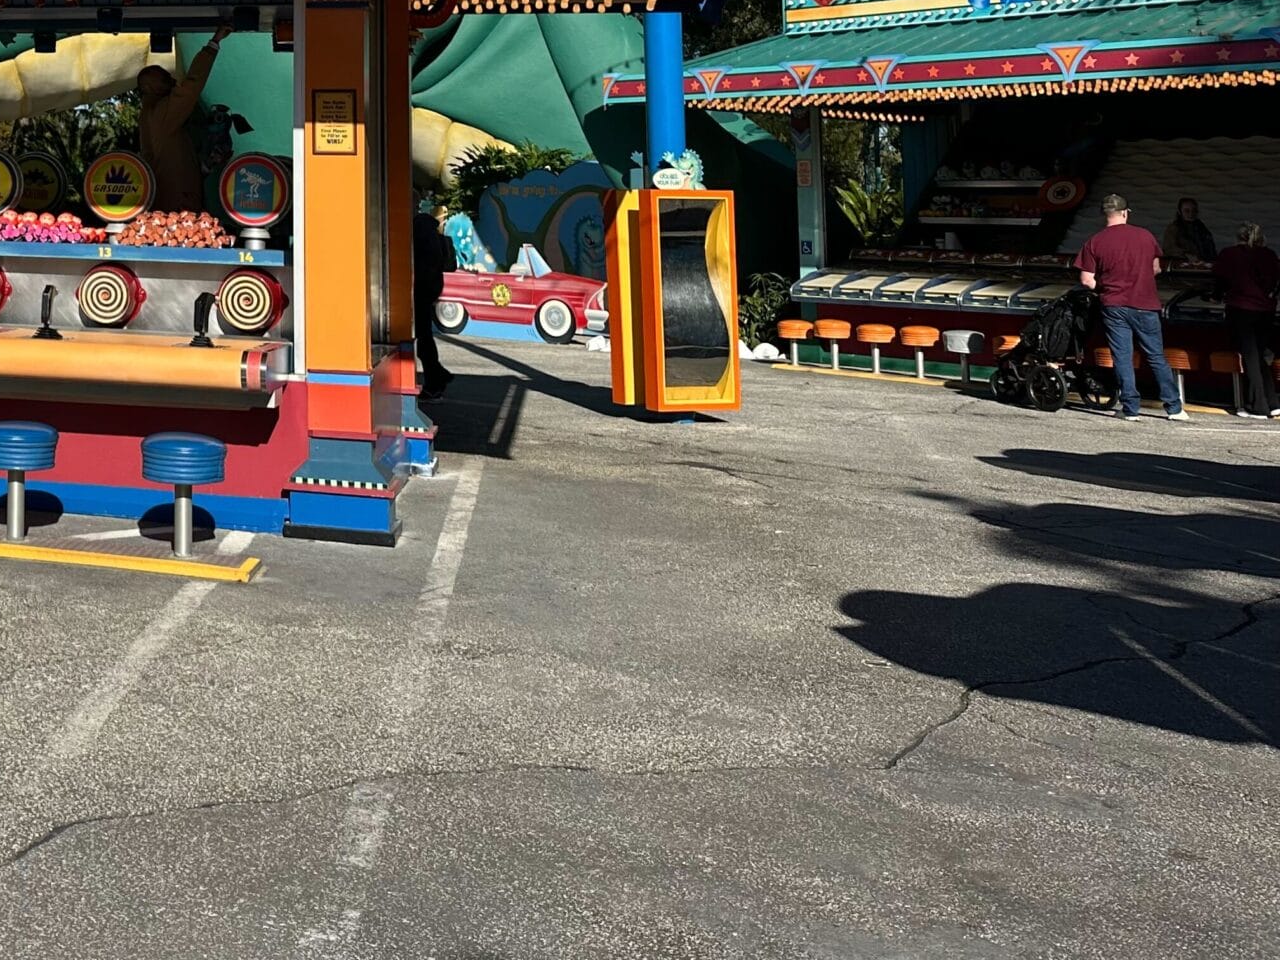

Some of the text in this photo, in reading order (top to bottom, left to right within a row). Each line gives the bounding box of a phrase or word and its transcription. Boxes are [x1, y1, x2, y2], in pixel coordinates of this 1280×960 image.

[93, 183, 139, 193] GASODON
[98, 247, 112, 258] 13
[238, 252, 254, 263] 14
